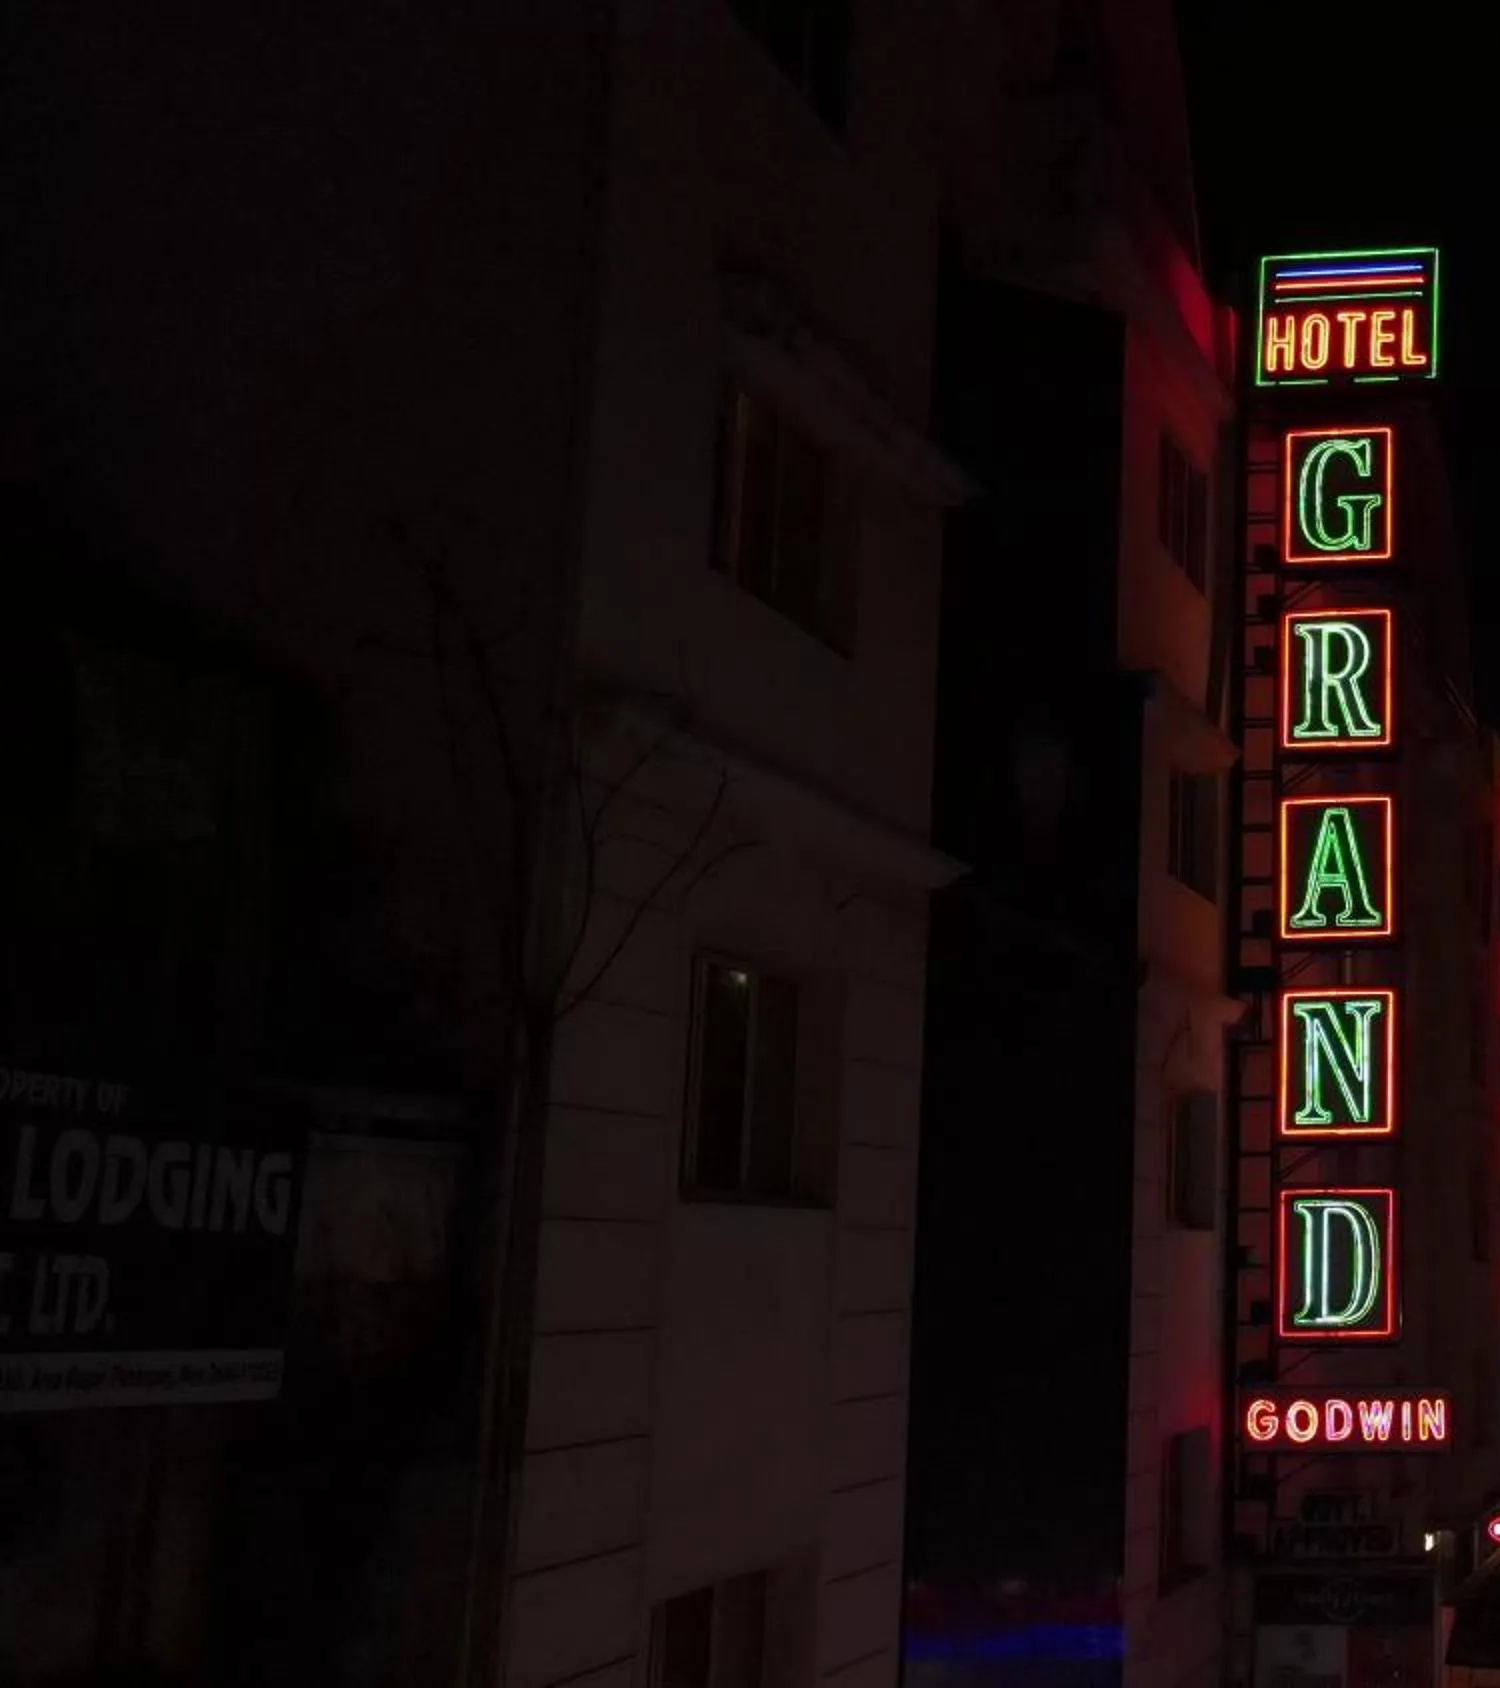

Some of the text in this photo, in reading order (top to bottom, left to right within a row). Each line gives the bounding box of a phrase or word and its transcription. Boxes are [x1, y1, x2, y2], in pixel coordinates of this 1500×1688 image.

[1266, 309, 1427, 372] HOTEL
[1291, 438, 1381, 1326] GRAND
[8, 1124, 294, 1236] LODGING
[28, 1252, 116, 1335] LTD.
[1246, 1398, 1446, 1442] GODWIN
